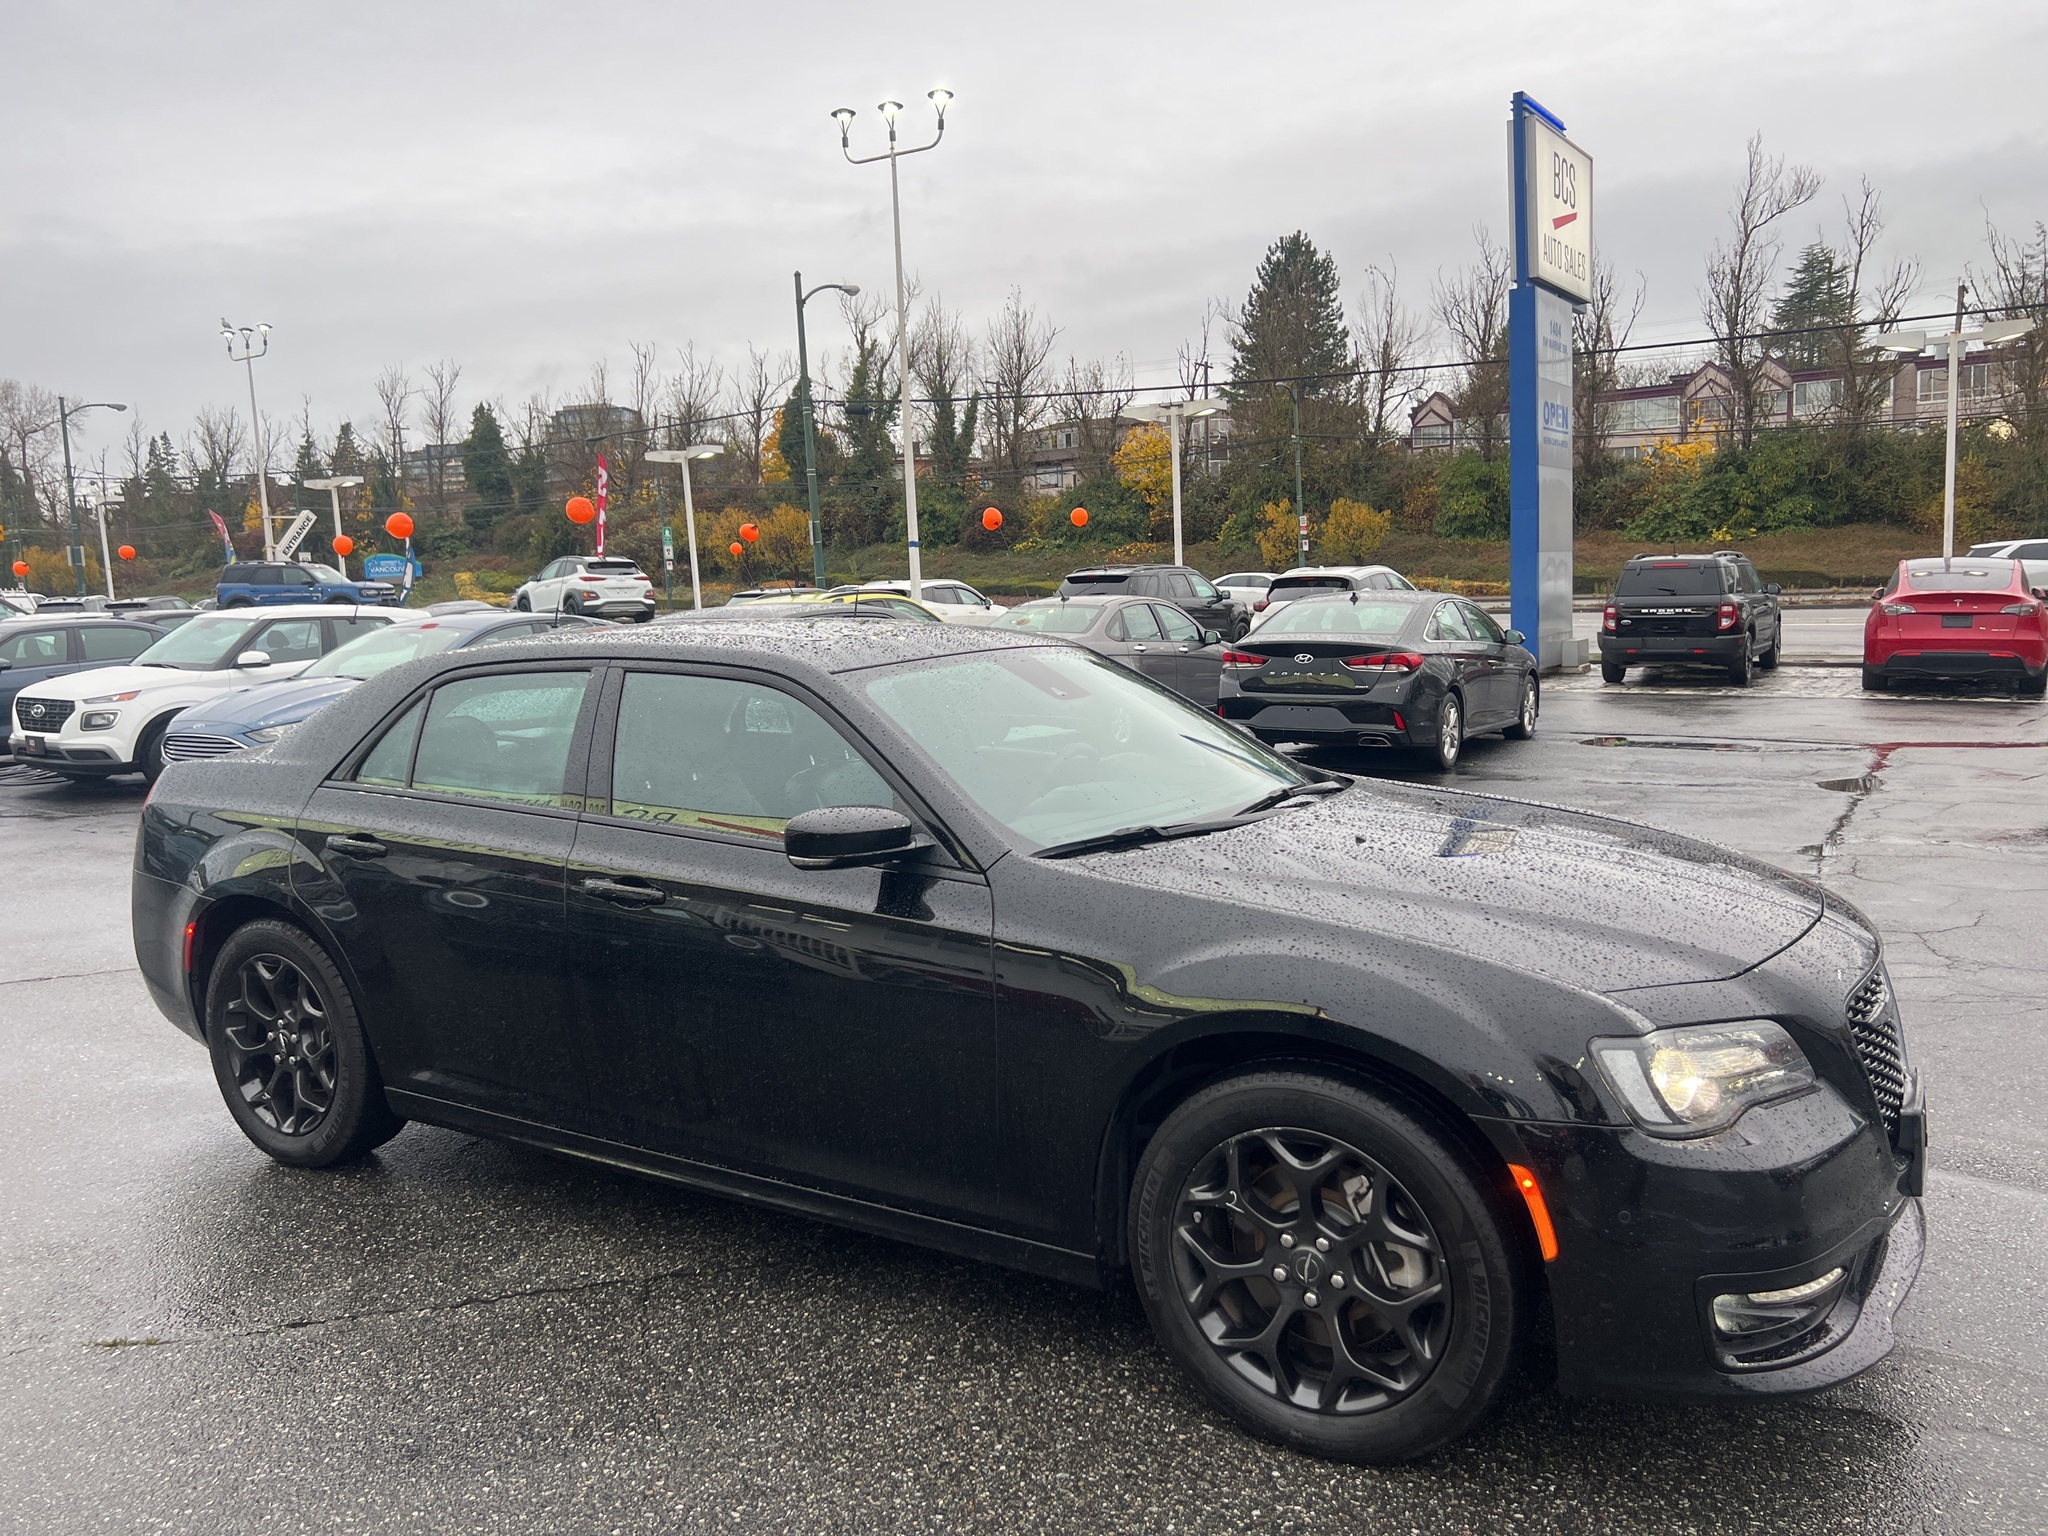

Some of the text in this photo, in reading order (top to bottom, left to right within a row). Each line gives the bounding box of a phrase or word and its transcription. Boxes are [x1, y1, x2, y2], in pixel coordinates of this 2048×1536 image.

[1553, 150, 1576, 210] BCS
[1543, 232, 1586, 282] AUTO SALES
[1543, 400, 1569, 430] OPEN
[282, 515, 313, 556] ENTRANCE
[370, 565, 405, 573] VANCOUV
[1138, 1169, 1161, 1275] MICHELIN
[1463, 1272, 1490, 1387] MICHELIN
